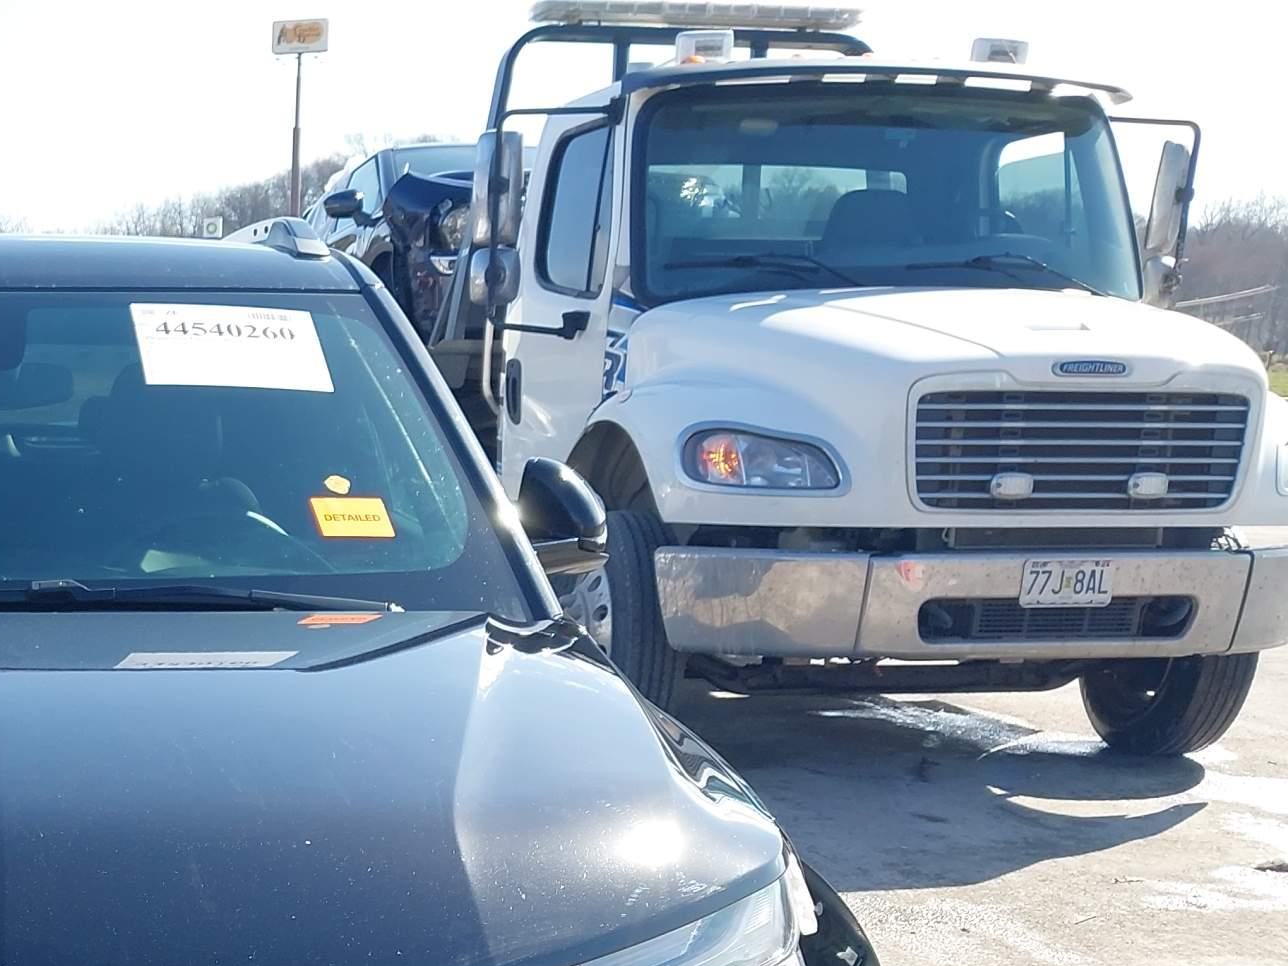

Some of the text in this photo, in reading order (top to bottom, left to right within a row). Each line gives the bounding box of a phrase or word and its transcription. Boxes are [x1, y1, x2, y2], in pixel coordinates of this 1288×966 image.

[155, 321, 296, 340] 44540260
[1061, 362, 1124, 373] FREIGHTLINER
[323, 513, 381, 522] DETAILED
[1027, 569, 1109, 595] 77J 8AL
